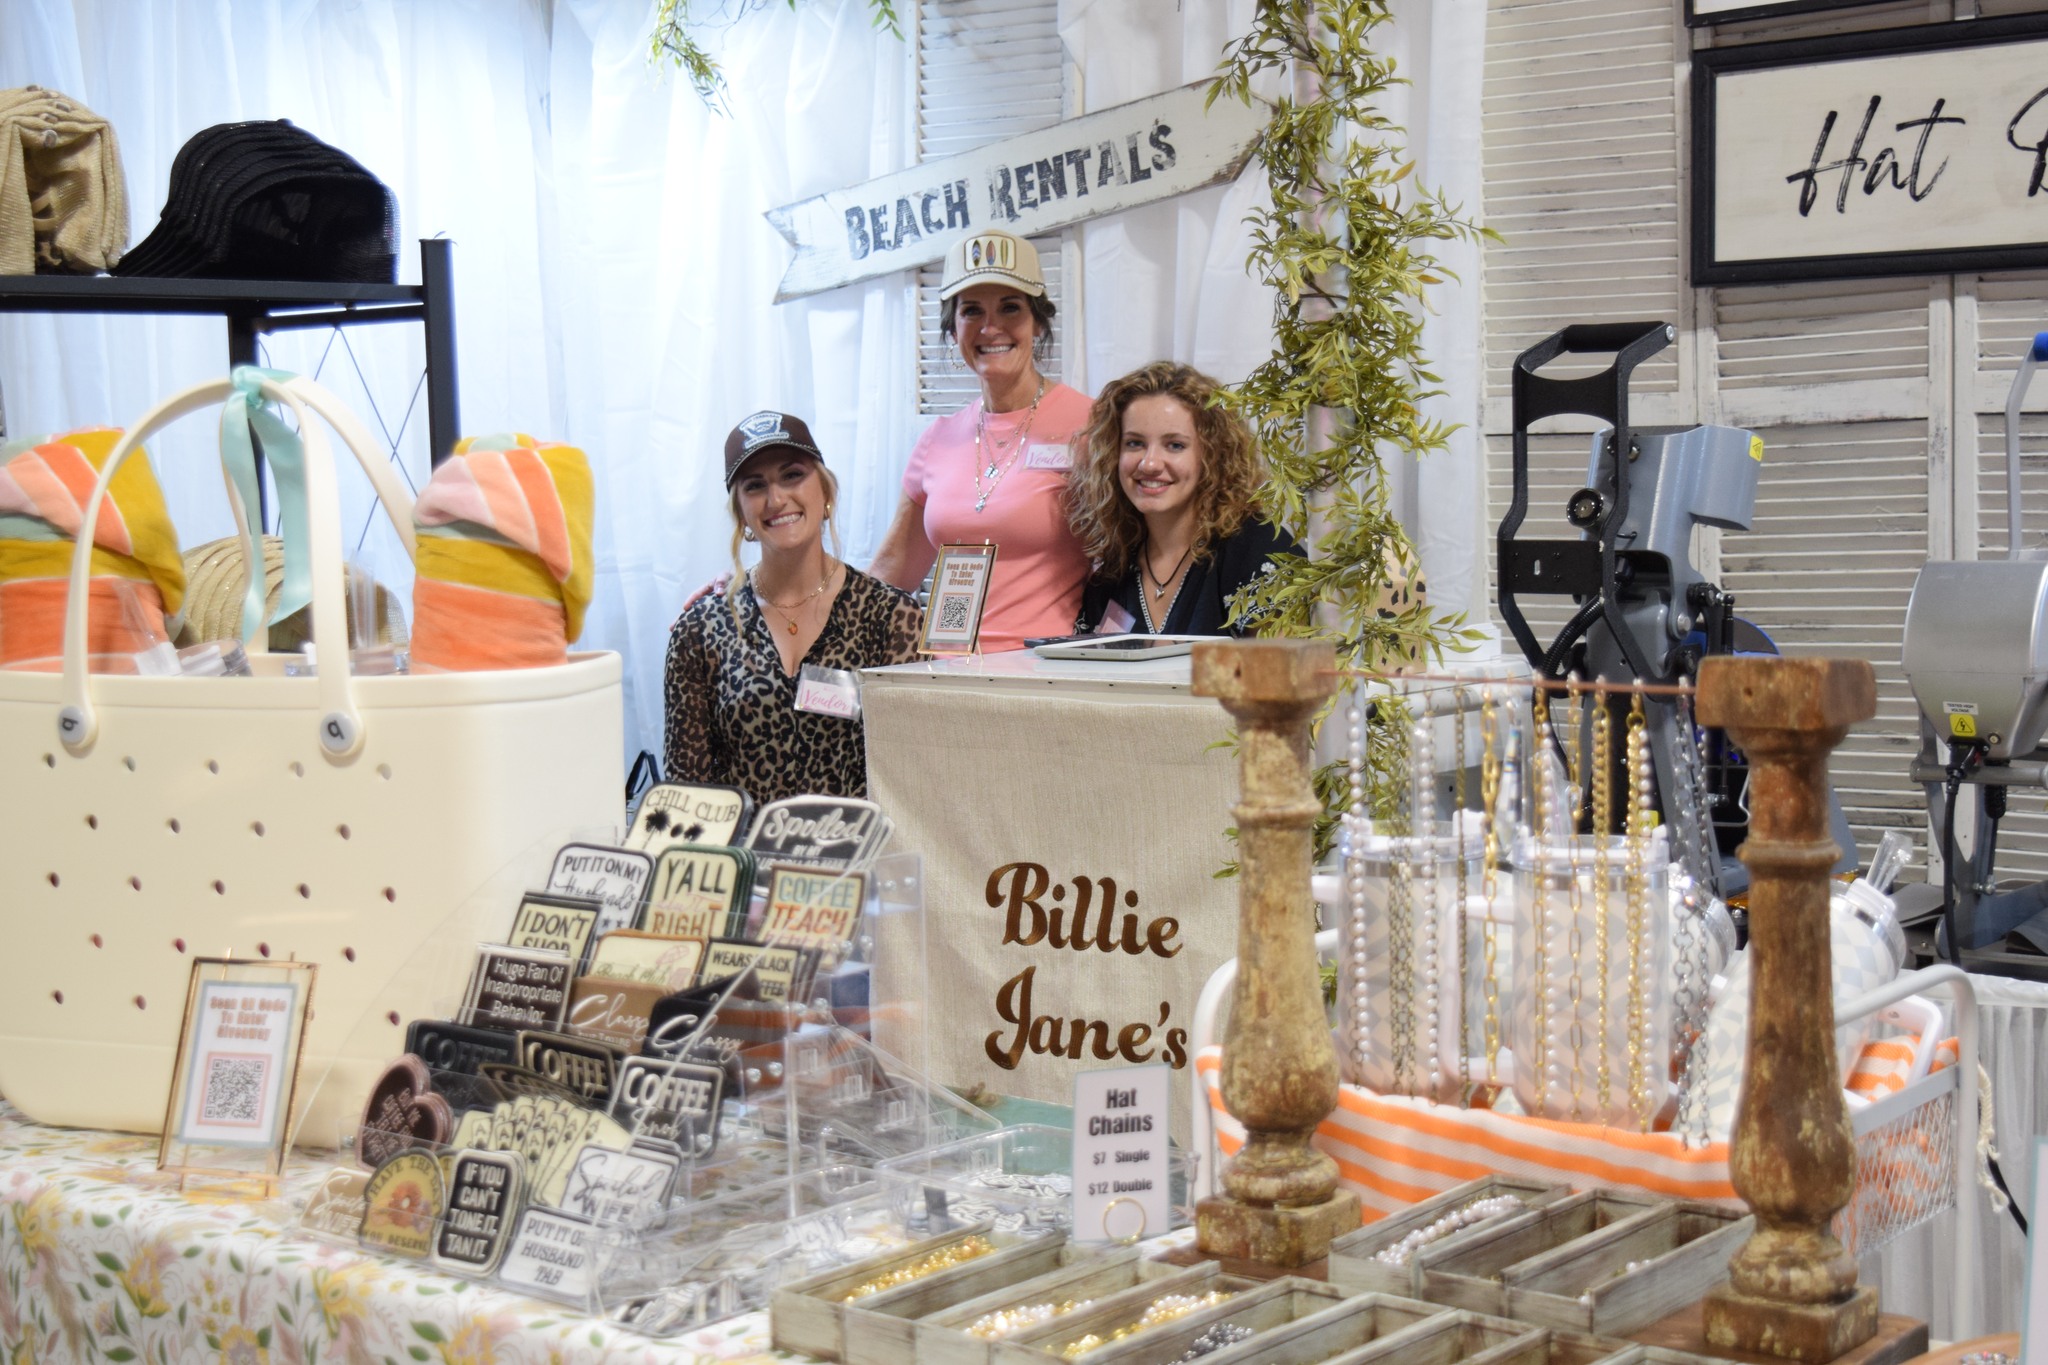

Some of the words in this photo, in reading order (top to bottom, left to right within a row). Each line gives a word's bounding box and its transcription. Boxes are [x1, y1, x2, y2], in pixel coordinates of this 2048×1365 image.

[1786, 95, 1966, 217] Hat
[845, 178, 972, 260] BEACH
[990, 116, 1177, 222] RENTALS
[805, 688, 849, 711] Vendor
[646, 789, 690, 814] CHILL
[694, 801, 740, 823] CLUB
[763, 807, 872, 850] Spoiled
[562, 856, 592, 873] PUT
[590, 856, 608, 873] IT
[605, 857, 625, 877] ON
[624, 863, 645, 884] MY
[663, 858, 727, 901] Y'ALL
[778, 876, 857, 909] COFFEE
[652, 903, 723, 936] RIGHT
[771, 902, 848, 936] TEACH
[985, 862, 1183, 959] Billie
[520, 910, 531, 932] I
[529, 911, 591, 940] DON'T
[495, 957, 526, 981] Huge
[527, 962, 549, 980] Fan
[550, 966, 565, 983] Of
[713, 950, 753, 968] WEARS
[210, 996, 238, 1010] Scan
[485, 976, 563, 1004] Inappropriate
[221, 1011, 234, 1024] To
[237, 1011, 268, 1025] Enter
[985, 965, 1187, 1070] Jane's
[216, 1024, 272, 1041] Giveaway
[525, 1042, 610, 1092] COFFEE
[623, 1067, 713, 1114] COFFEE
[1106, 1087, 1138, 1109] Hat
[1089, 1113, 1154, 1137] Chains
[1093, 1151, 1107, 1166] $7
[1115, 1149, 1150, 1164] Single
[369, 1159, 404, 1196] HAVE
[409, 1155, 432, 1175] THE
[464, 1162, 479, 1184] IF
[479, 1164, 506, 1187] YOU
[1088, 1182, 1109, 1196] $12
[1113, 1178, 1153, 1193] Double
[460, 1186, 501, 1211] CAN'T
[582, 1196, 635, 1223] WIFE
[449, 1207, 485, 1232] TONE
[525, 1217, 556, 1239] PUT
[555, 1224, 571, 1242] IT
[446, 1233, 475, 1257] TAN
[520, 1240, 585, 1269] HUSBAND
[534, 1265, 564, 1286] TAB
